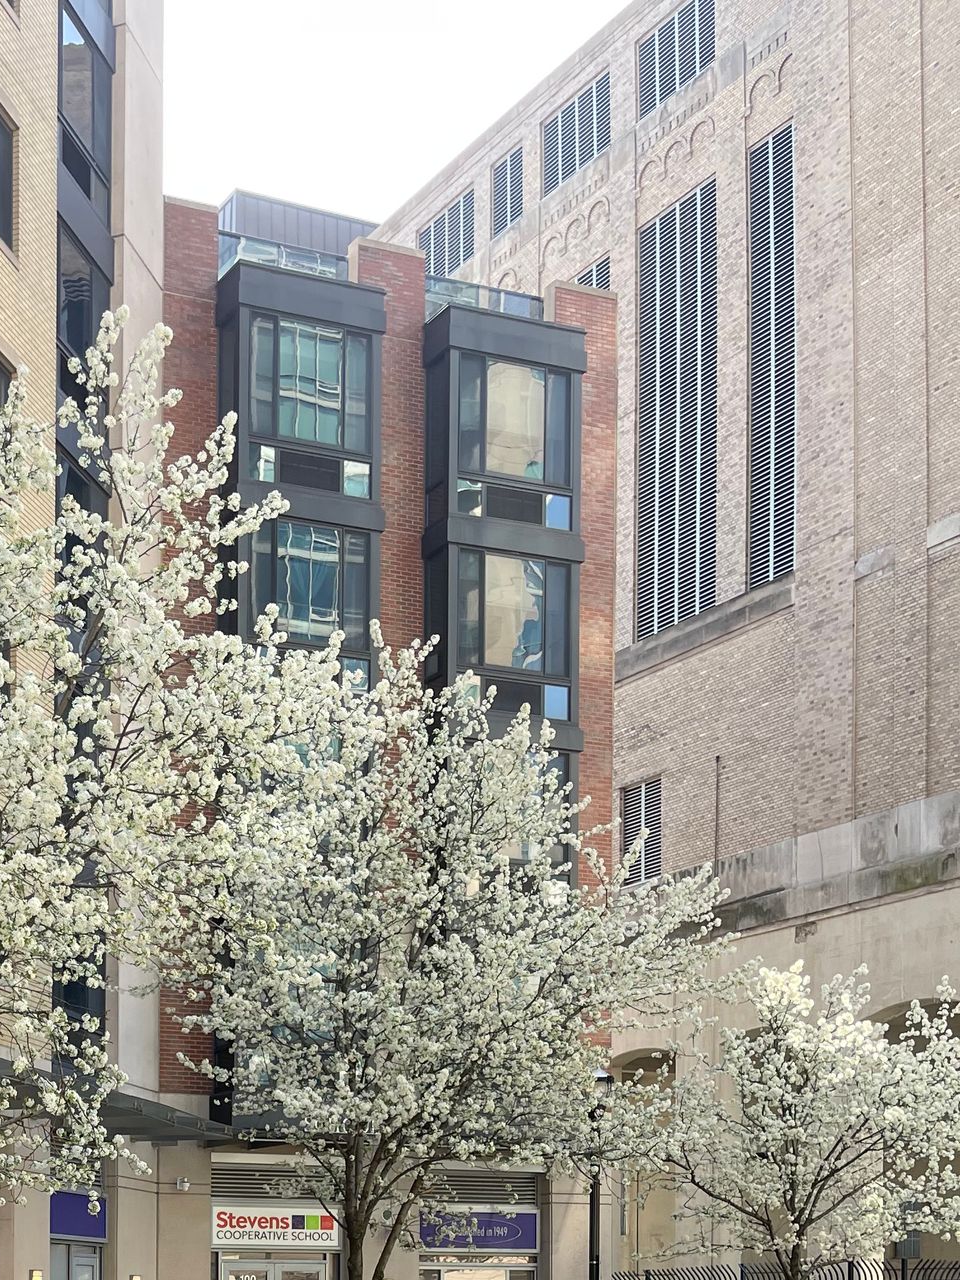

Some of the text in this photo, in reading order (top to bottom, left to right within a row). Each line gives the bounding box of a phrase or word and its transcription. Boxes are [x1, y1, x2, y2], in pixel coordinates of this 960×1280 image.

[216, 1211, 290, 1230] Stevens
[216, 1230, 335, 1242] COOPERATIVE SCHOOL
[493, 1226, 508, 1237] 1949
